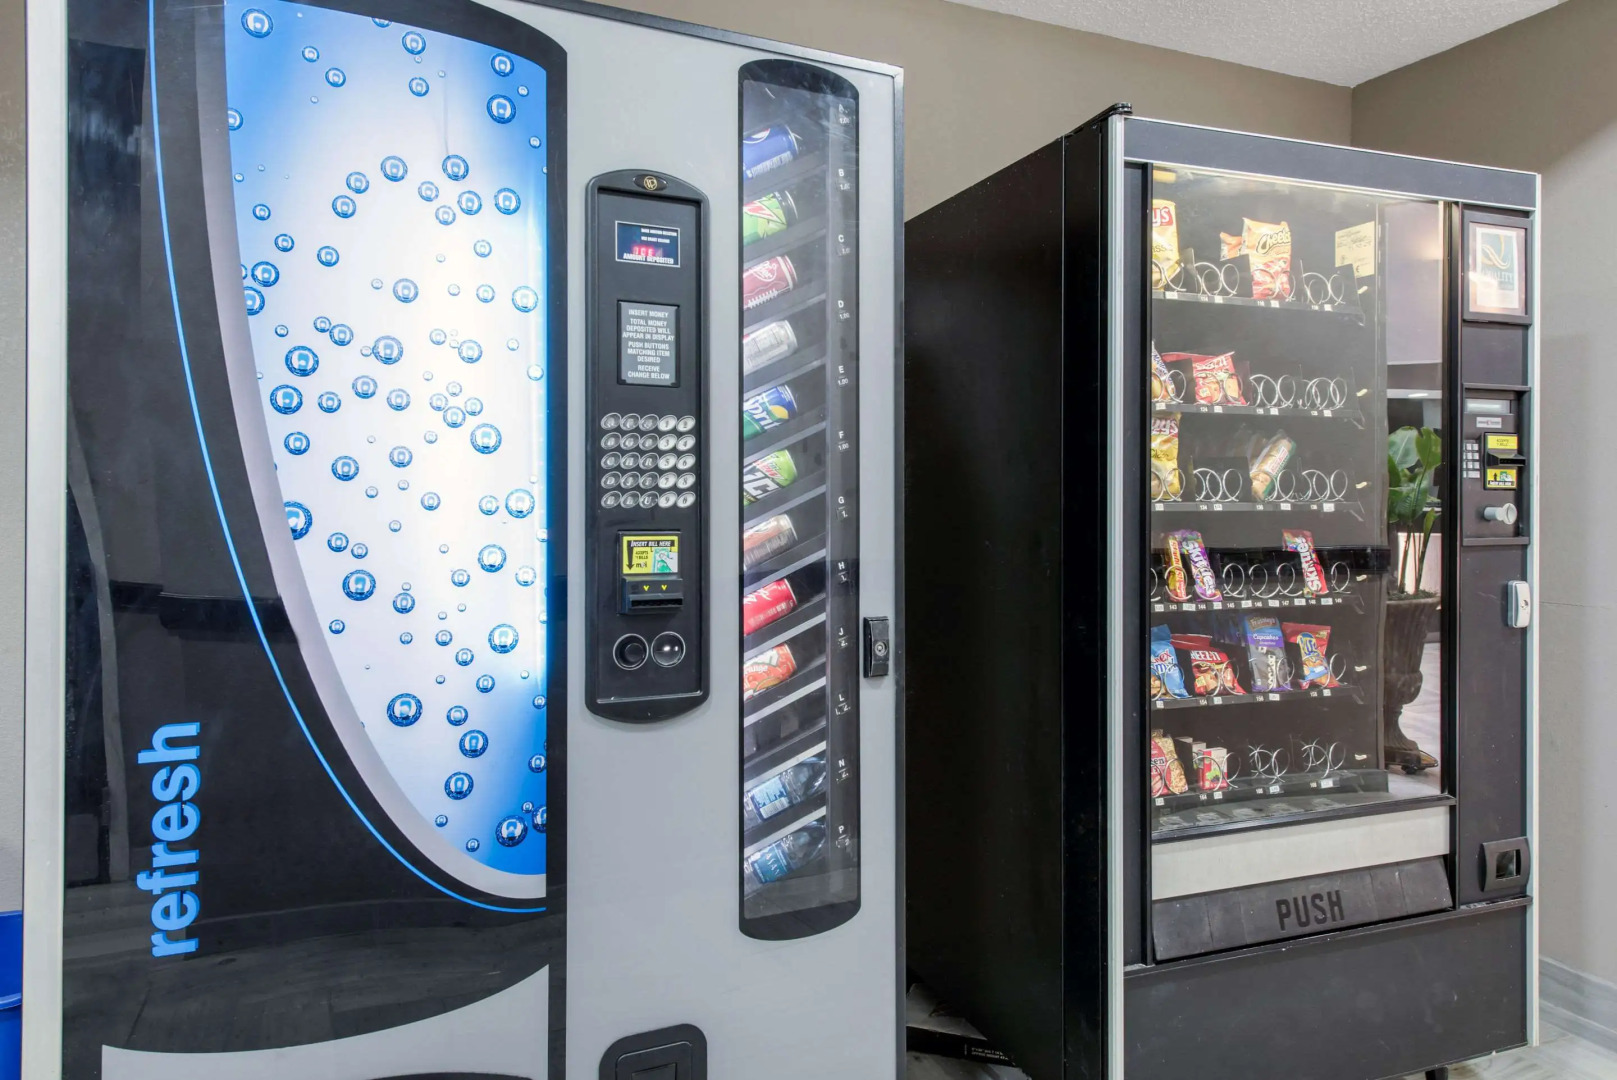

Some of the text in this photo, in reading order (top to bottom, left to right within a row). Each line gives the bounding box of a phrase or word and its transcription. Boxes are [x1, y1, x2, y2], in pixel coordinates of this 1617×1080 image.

[626, 325, 656, 333] DEPOSITED
[1253, 633, 1280, 641] Cupcakes
[839, 759, 845, 768] N
[136, 722, 200, 958] refresh
[1276, 890, 1345, 930] PUSH
